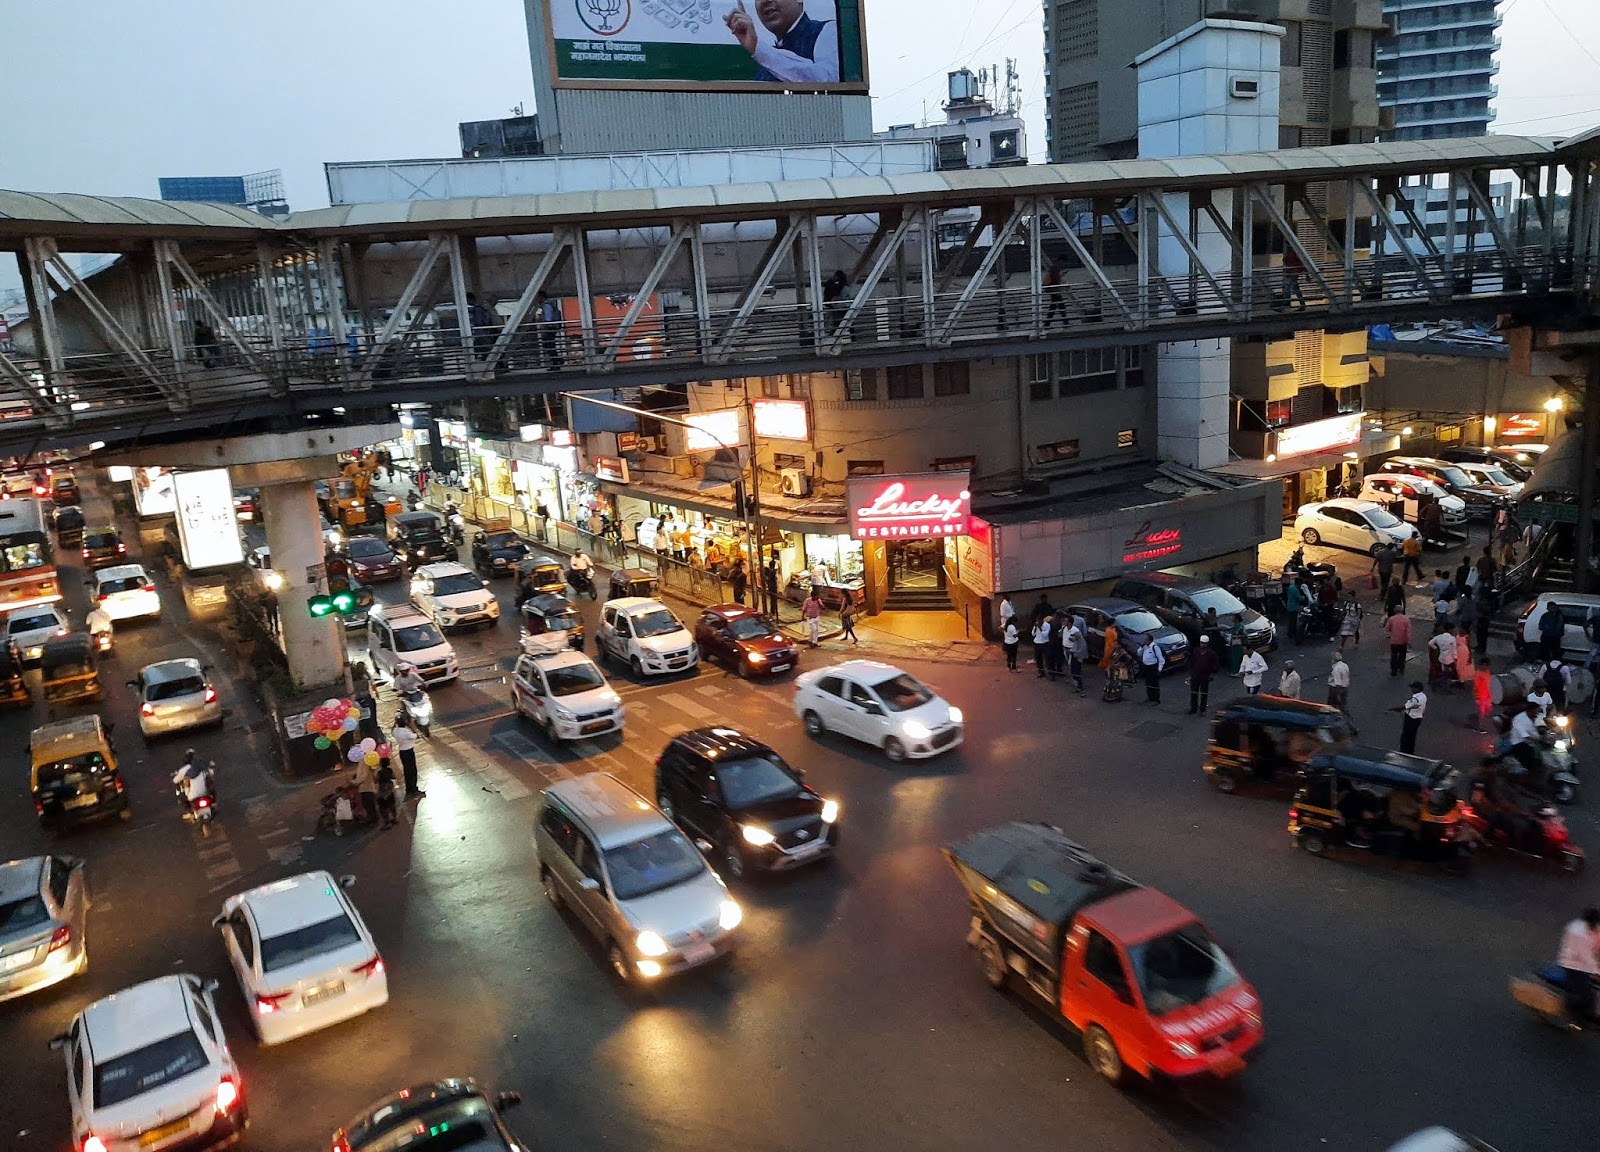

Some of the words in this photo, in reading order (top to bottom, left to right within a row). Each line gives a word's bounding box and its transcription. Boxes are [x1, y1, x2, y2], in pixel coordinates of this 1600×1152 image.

[857, 483, 962, 521] Lucky
[857, 524, 962, 537] RESTAURANT
[1125, 520, 1181, 546] Lucky
[963, 546, 983, 574] Lucky
[1123, 544, 1182, 563] RESTAURANT
